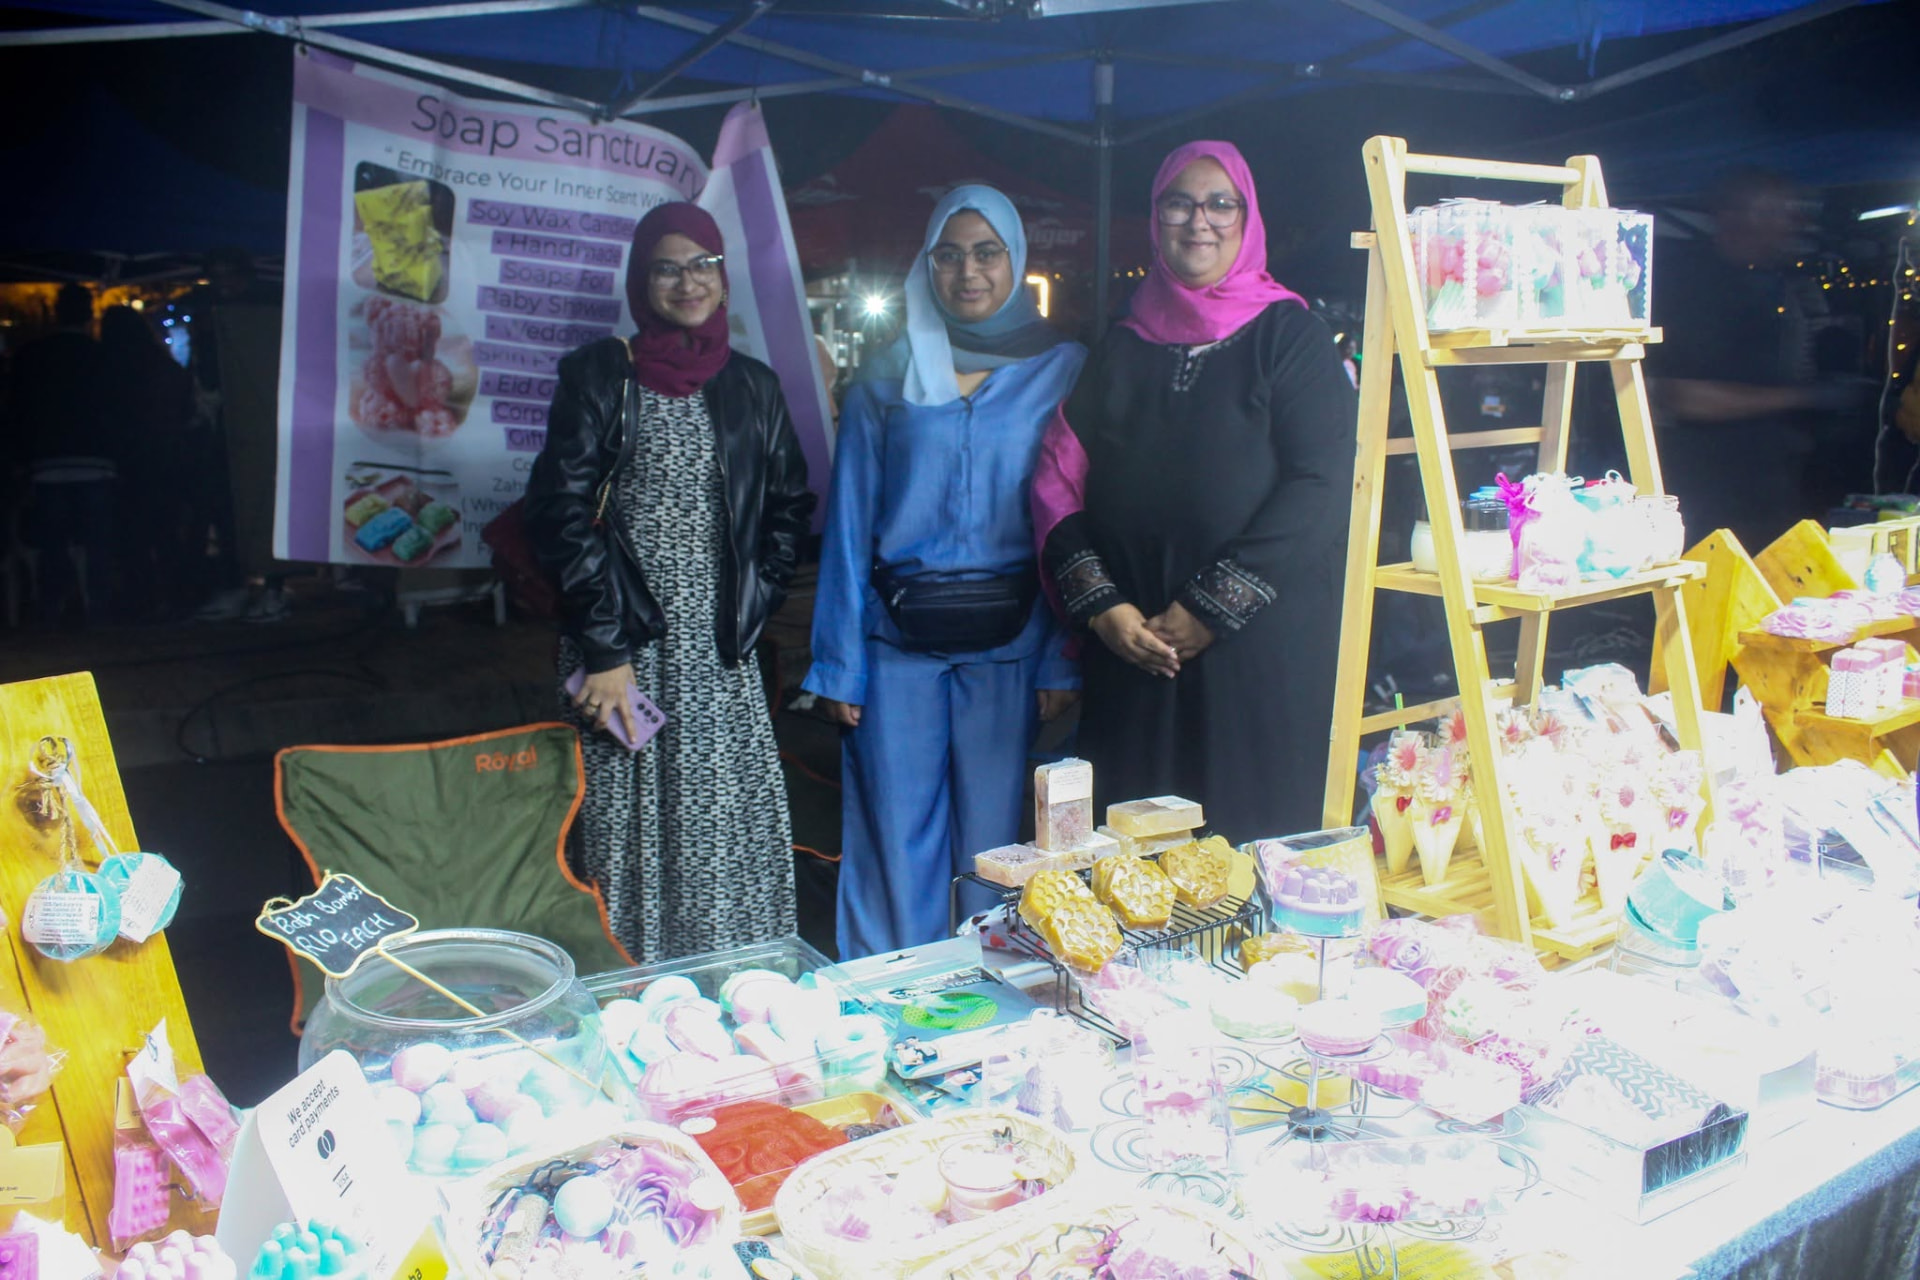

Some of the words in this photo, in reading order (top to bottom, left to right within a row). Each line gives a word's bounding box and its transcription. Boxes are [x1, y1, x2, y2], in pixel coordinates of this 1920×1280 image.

[411, 94, 519, 155] Soap
[397, 149, 491, 187] Embrace
[498, 171, 546, 194] Your
[554, 176, 602, 199] Inner
[470, 200, 513, 226] Soy
[521, 206, 571, 229] Wax
[503, 261, 574, 287] Soaps
[581, 269, 610, 289] For
[497, 373, 533, 396] Eid
[494, 401, 545, 424] Corp
[508, 428, 545, 447] Gift
[275, 910, 321, 936] Bath
[312, 885, 363, 915] Bombs
[341, 912, 395, 951] EACH
[287, 1107, 302, 1125] We
[301, 1079, 327, 1112] accept
[289, 1119, 307, 1148] card
[305, 1086, 340, 1133] payments
